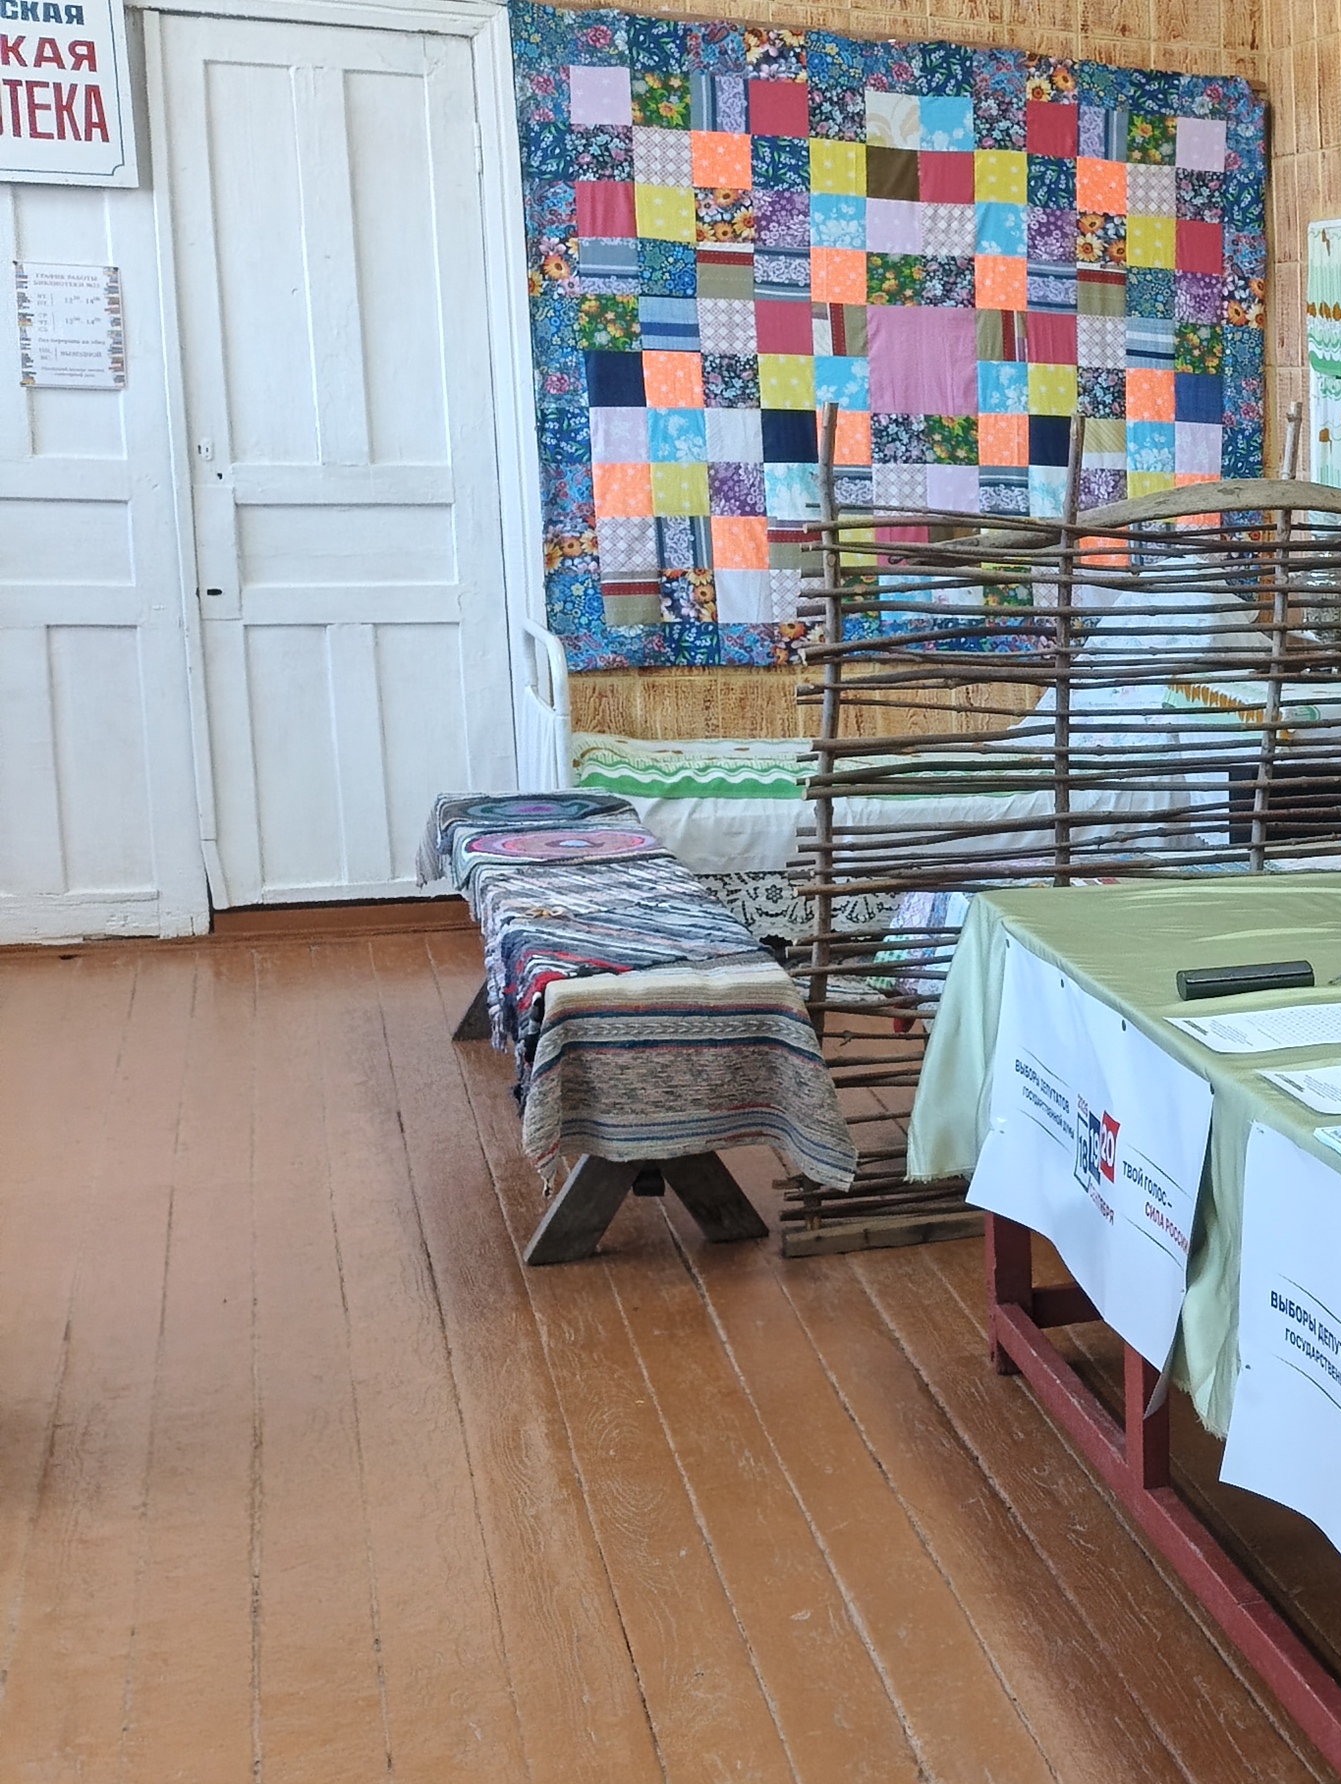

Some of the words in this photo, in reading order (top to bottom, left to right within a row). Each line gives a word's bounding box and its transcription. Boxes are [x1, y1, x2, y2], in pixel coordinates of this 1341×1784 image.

[0, 78, 110, 143] ТЕКА
[1079, 1135, 1089, 1175] 18
[1089, 1128, 1100, 1169] 19
[1101, 1123, 1116, 1168] 20
[1123, 1161, 1144, 1188] ТВОЙ
[1144, 1179, 1167, 1207] ГОЛОС
[1145, 1201, 1165, 1230] СИЛА
[1270, 1290, 1316, 1335] ВЫБОРЫ
